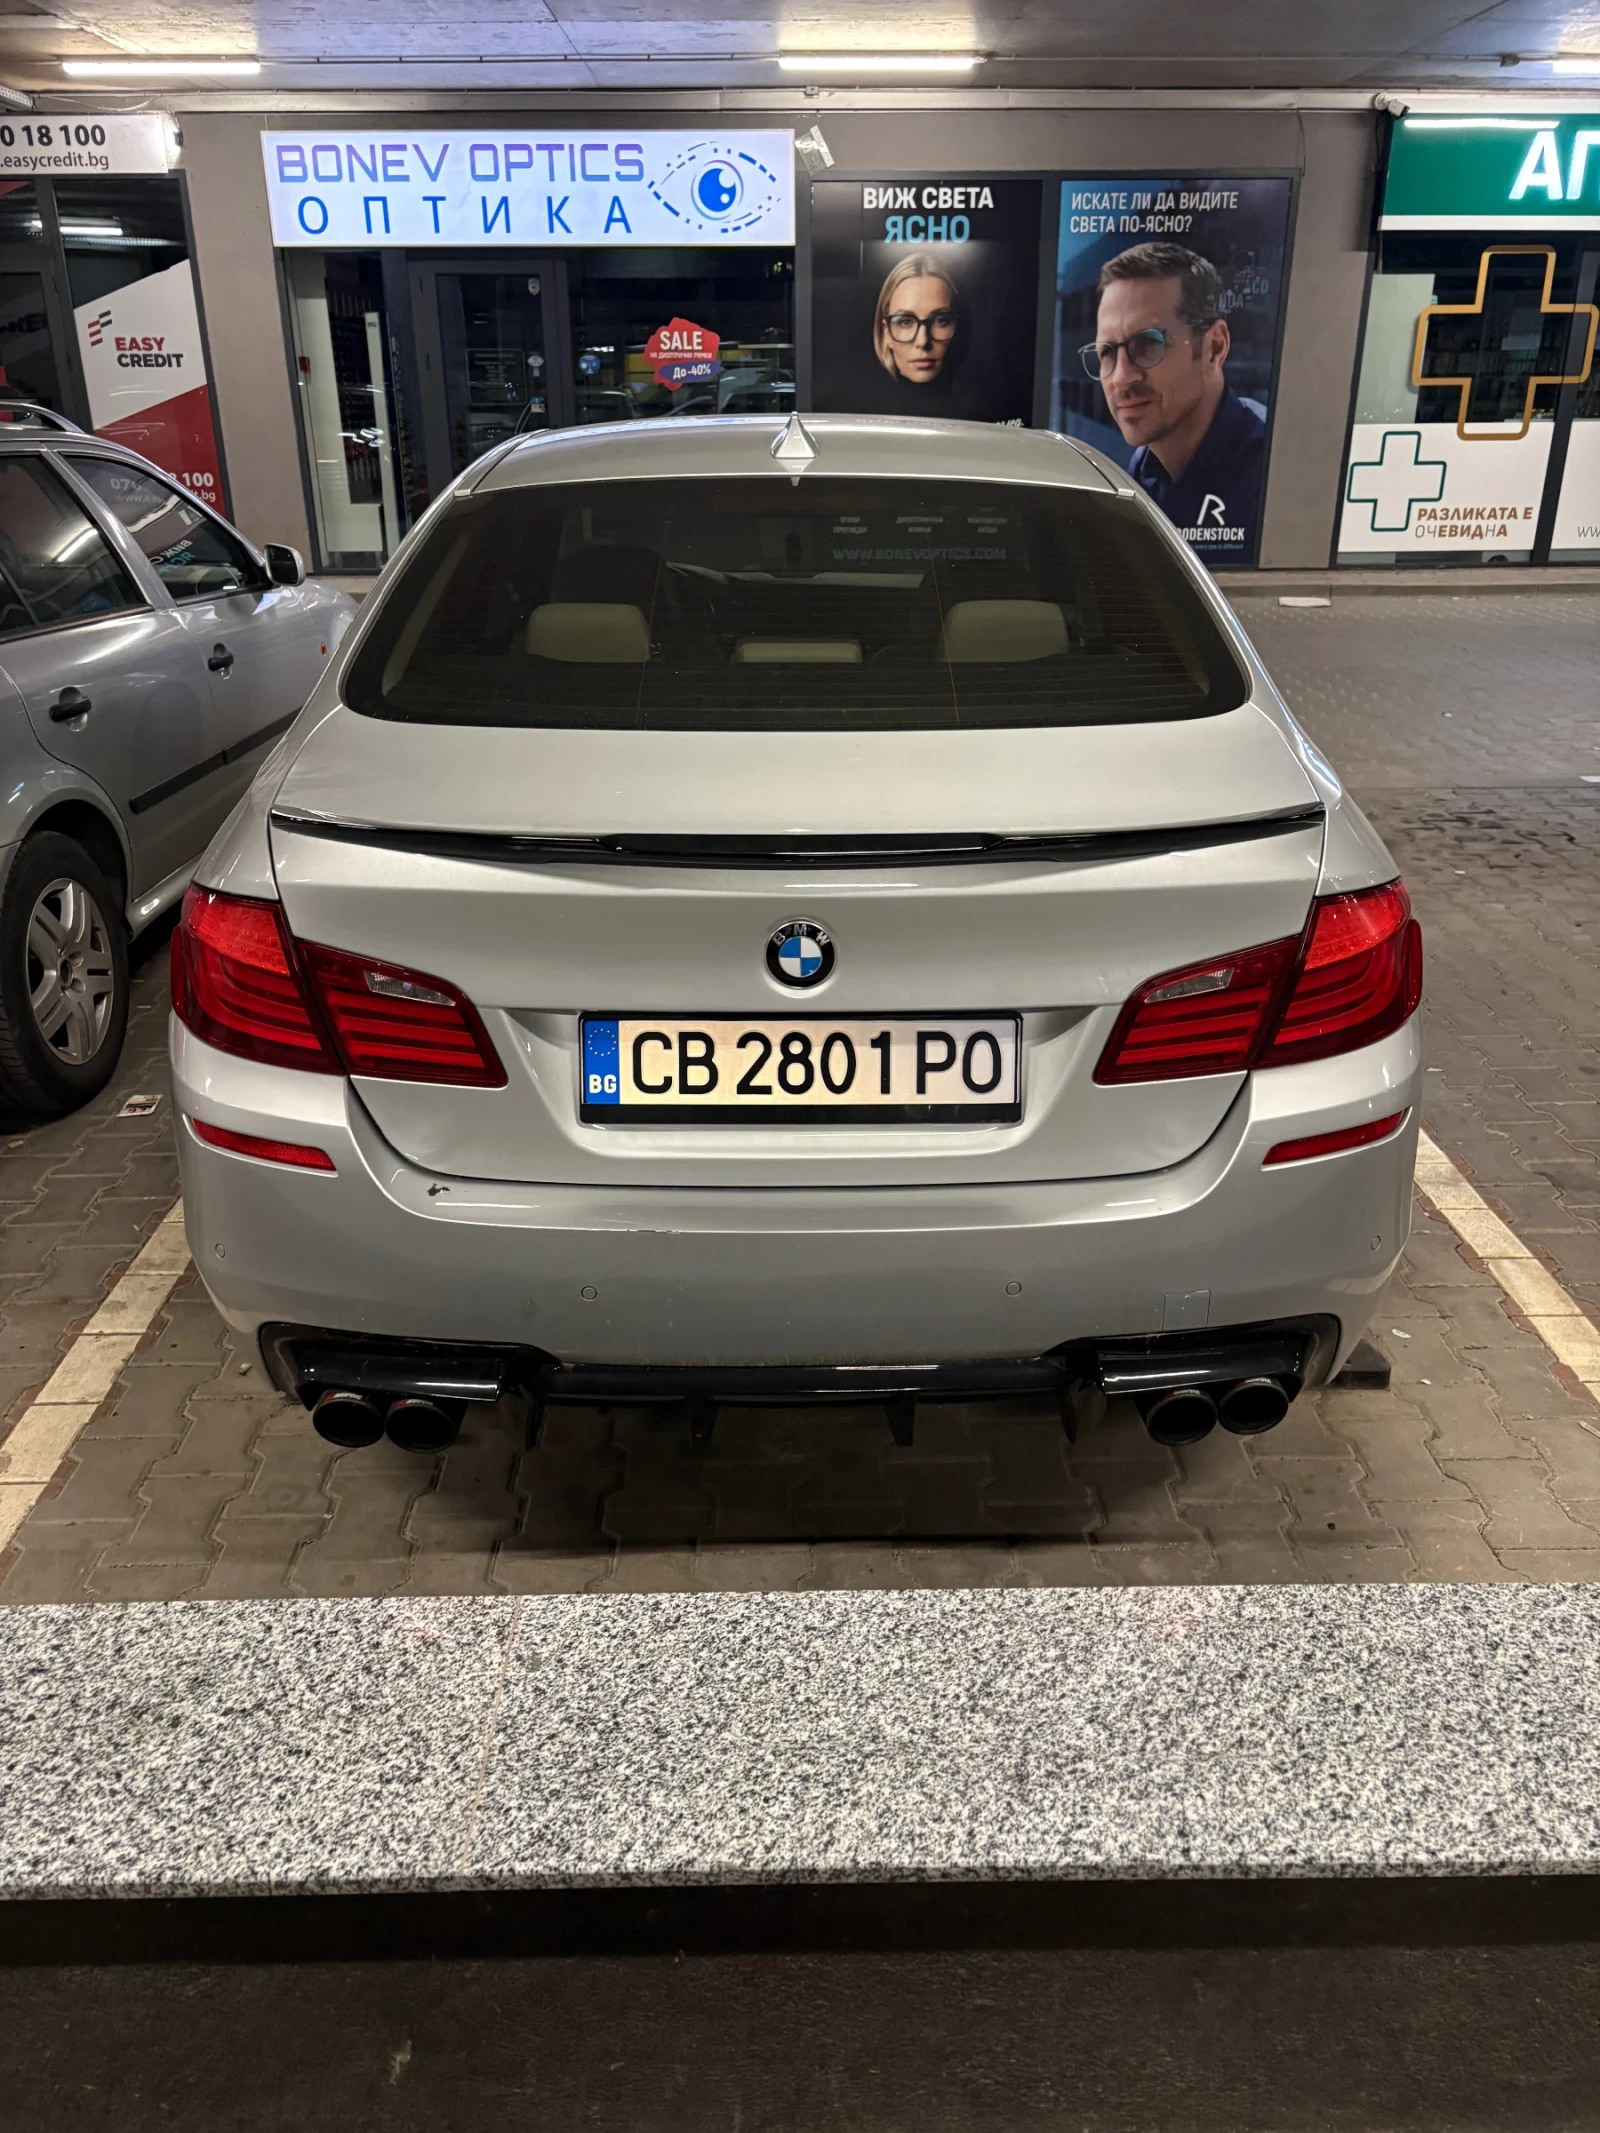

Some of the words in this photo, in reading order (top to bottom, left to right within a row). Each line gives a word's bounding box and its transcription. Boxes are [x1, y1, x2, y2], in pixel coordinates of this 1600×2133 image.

[21, 124, 53, 147] 18
[59, 124, 106, 147] 100
[276, 143, 450, 183] BONEV
[469, 143, 645, 183] OPTICS
[863, 186, 918, 209] ВИЖ
[921, 186, 995, 210] СВЕТА
[1071, 192, 1128, 211] ИСКАТЕ
[1130, 192, 1151, 211] ЛИ
[1154, 192, 1176, 212] ДА
[1179, 191, 1239, 212] ВИДИТЕ
[297, 195, 633, 235] ОПТИКА
[1069, 215, 1116, 234] СВЕТА
[1119, 215, 1193, 233] ПО-ЯСНО?
[884, 214, 971, 245] ЯСНО
[114, 337, 165, 352] EASY
[660, 331, 703, 350] SALE
[117, 353, 184, 368] CREDIT
[1417, 507, 1518, 521] РАЗЛИКАТА
[1523, 507, 1533, 520] Е
[1415, 524, 1508, 540] ОЧЕВИДНА
[771, 923, 831, 947] BMW
[632, 1031, 719, 1095] CB
[736, 1031, 891, 1095] 2801
[588, 1073, 617, 1094] BG
